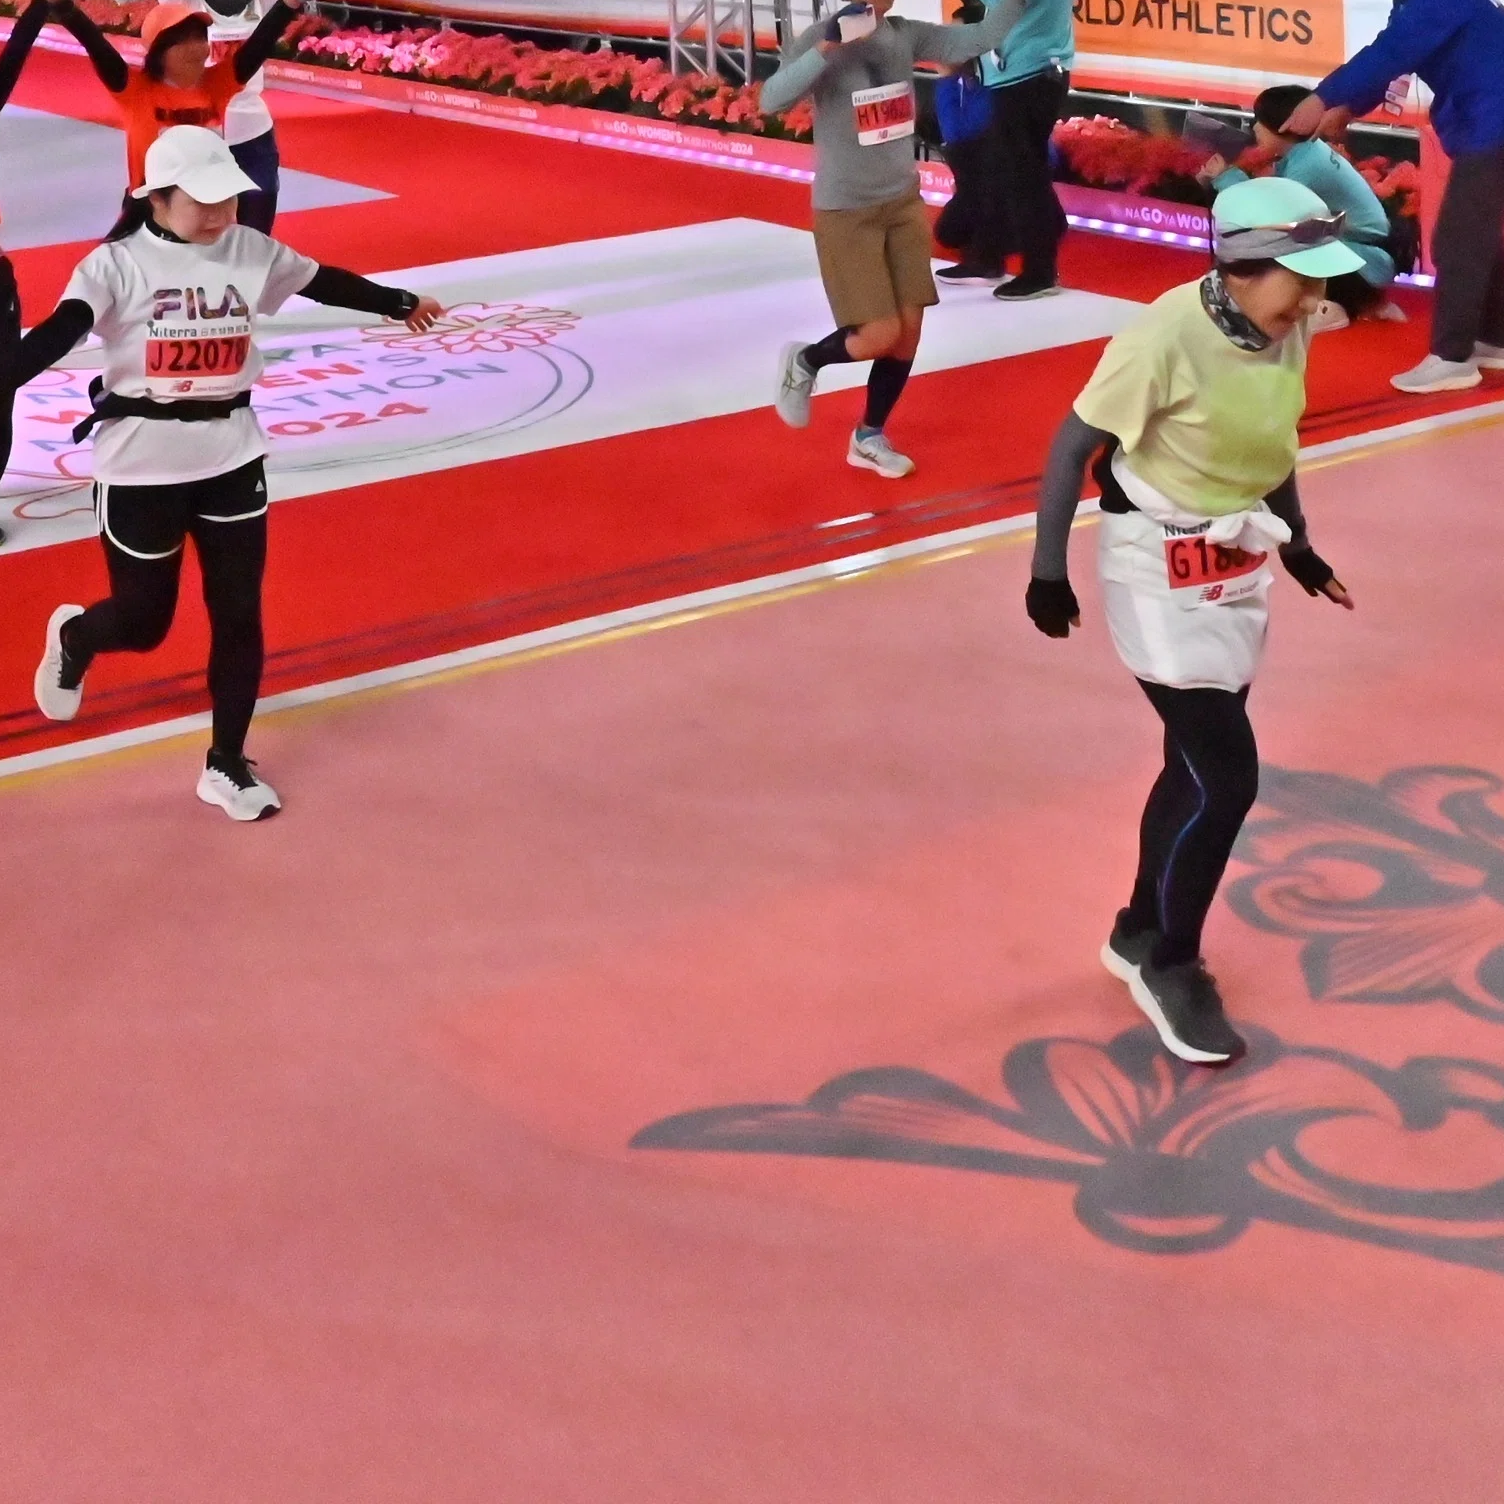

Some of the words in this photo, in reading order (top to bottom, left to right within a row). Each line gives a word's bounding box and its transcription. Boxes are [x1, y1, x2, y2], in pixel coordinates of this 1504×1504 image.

[637, 125, 683, 145] WOMEN'S
[729, 141, 754, 156] 2024
[1125, 206, 1176, 226] NAGOYA
[153, 283, 251, 322] FILA
[149, 327, 198, 338] Niterra
[267, 401, 430, 441] 024
